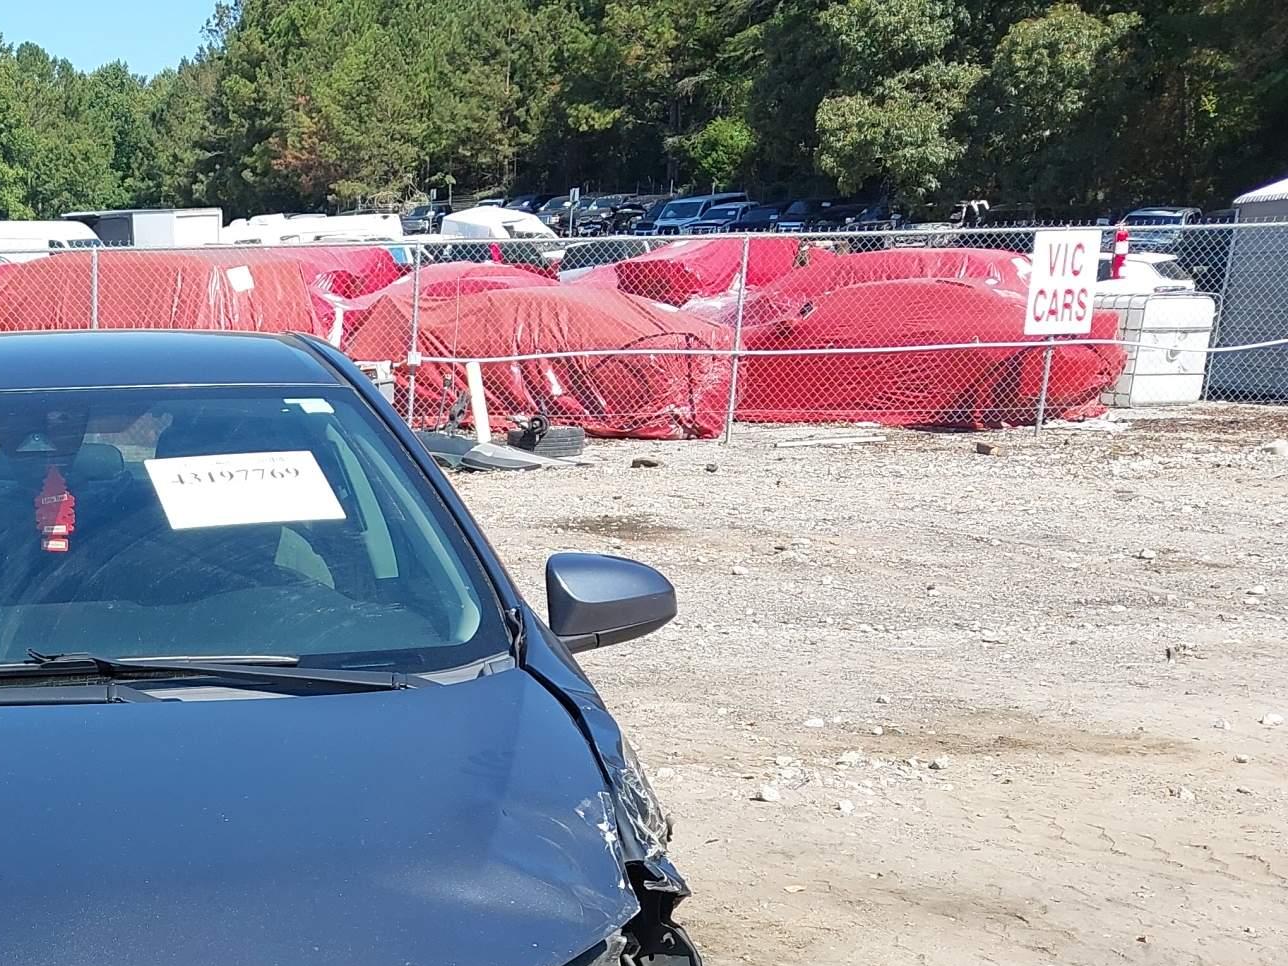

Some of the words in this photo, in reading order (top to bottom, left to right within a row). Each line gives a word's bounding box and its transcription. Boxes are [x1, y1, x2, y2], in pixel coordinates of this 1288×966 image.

[1048, 243, 1086, 277] VIC
[1033, 288, 1089, 322] CARS
[171, 467, 300, 485] 43197769
